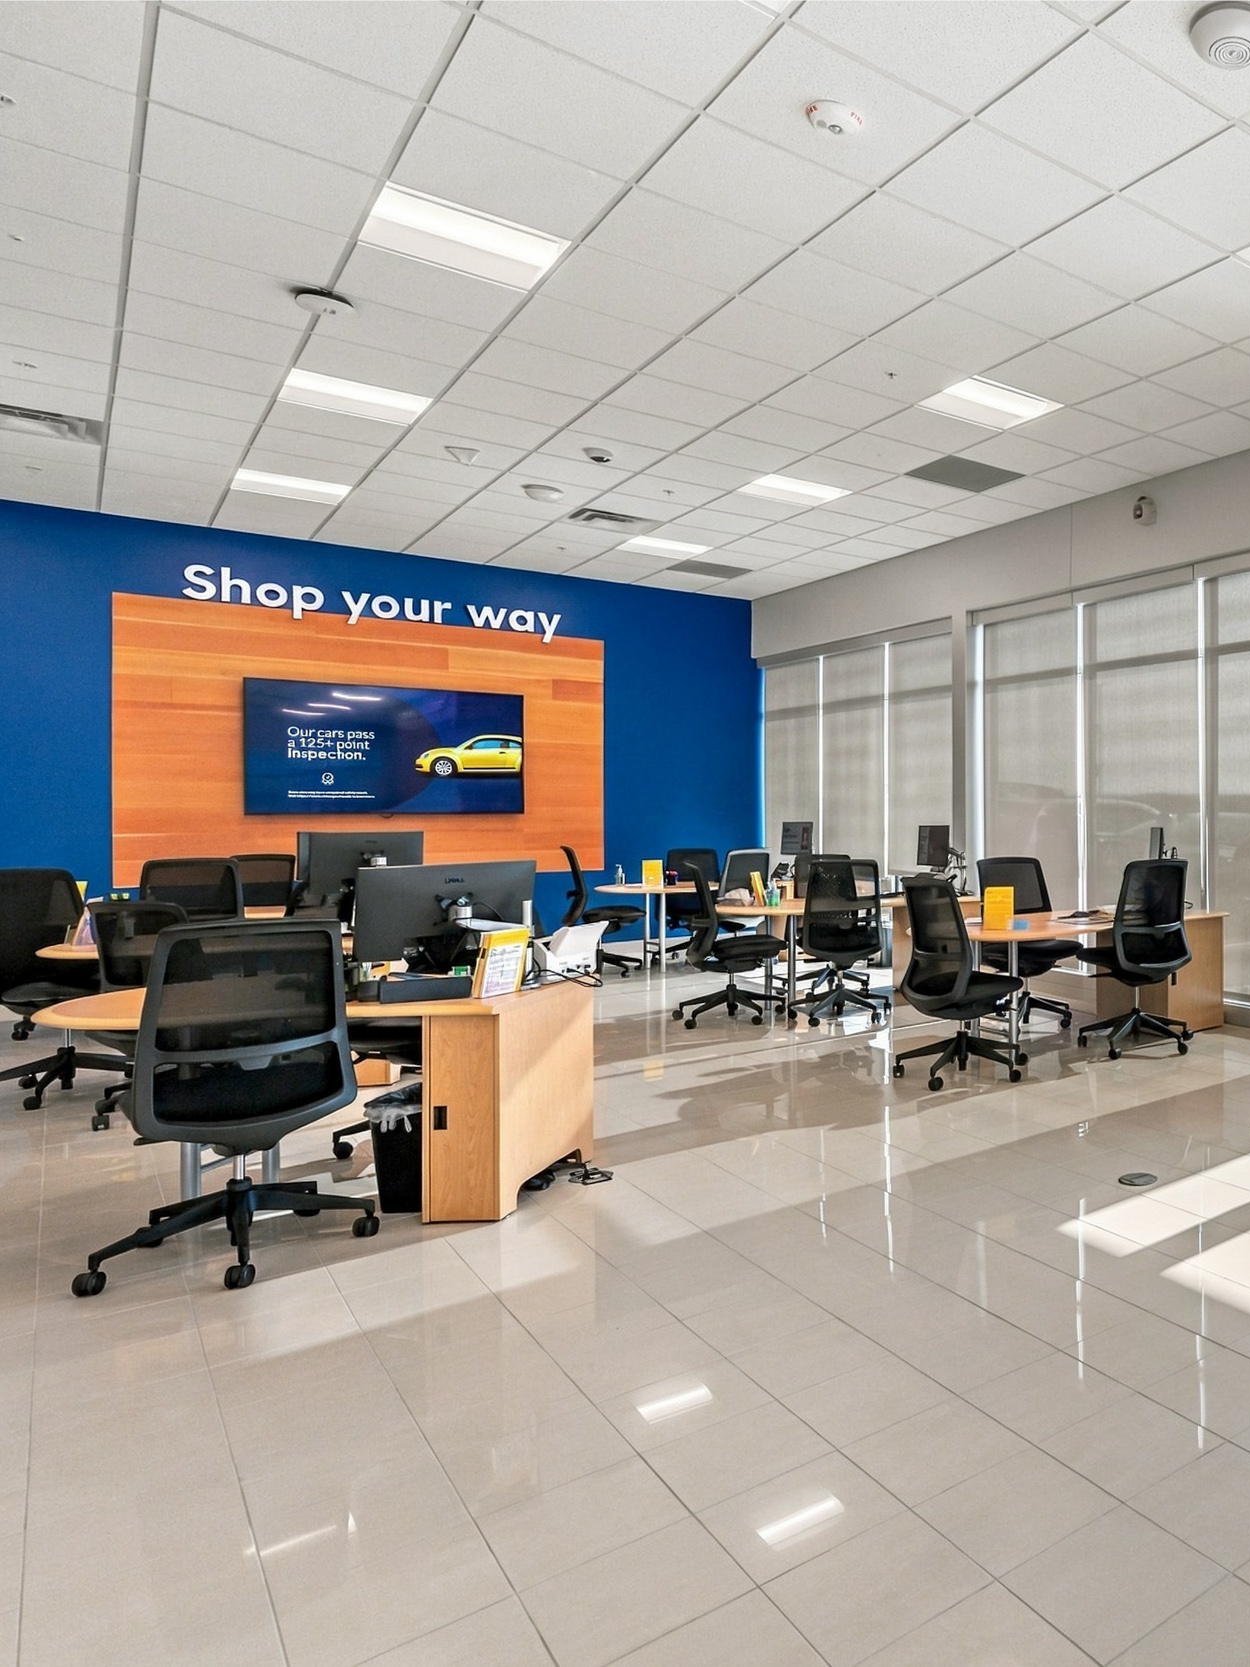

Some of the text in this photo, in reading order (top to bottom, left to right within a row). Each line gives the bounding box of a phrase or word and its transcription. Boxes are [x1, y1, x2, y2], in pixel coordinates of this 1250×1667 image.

[182, 564, 562, 644] Shop your way
[287, 726, 375, 741] Our cars pass
[299, 738, 334, 748] 125+
[336, 740, 370, 751] point
